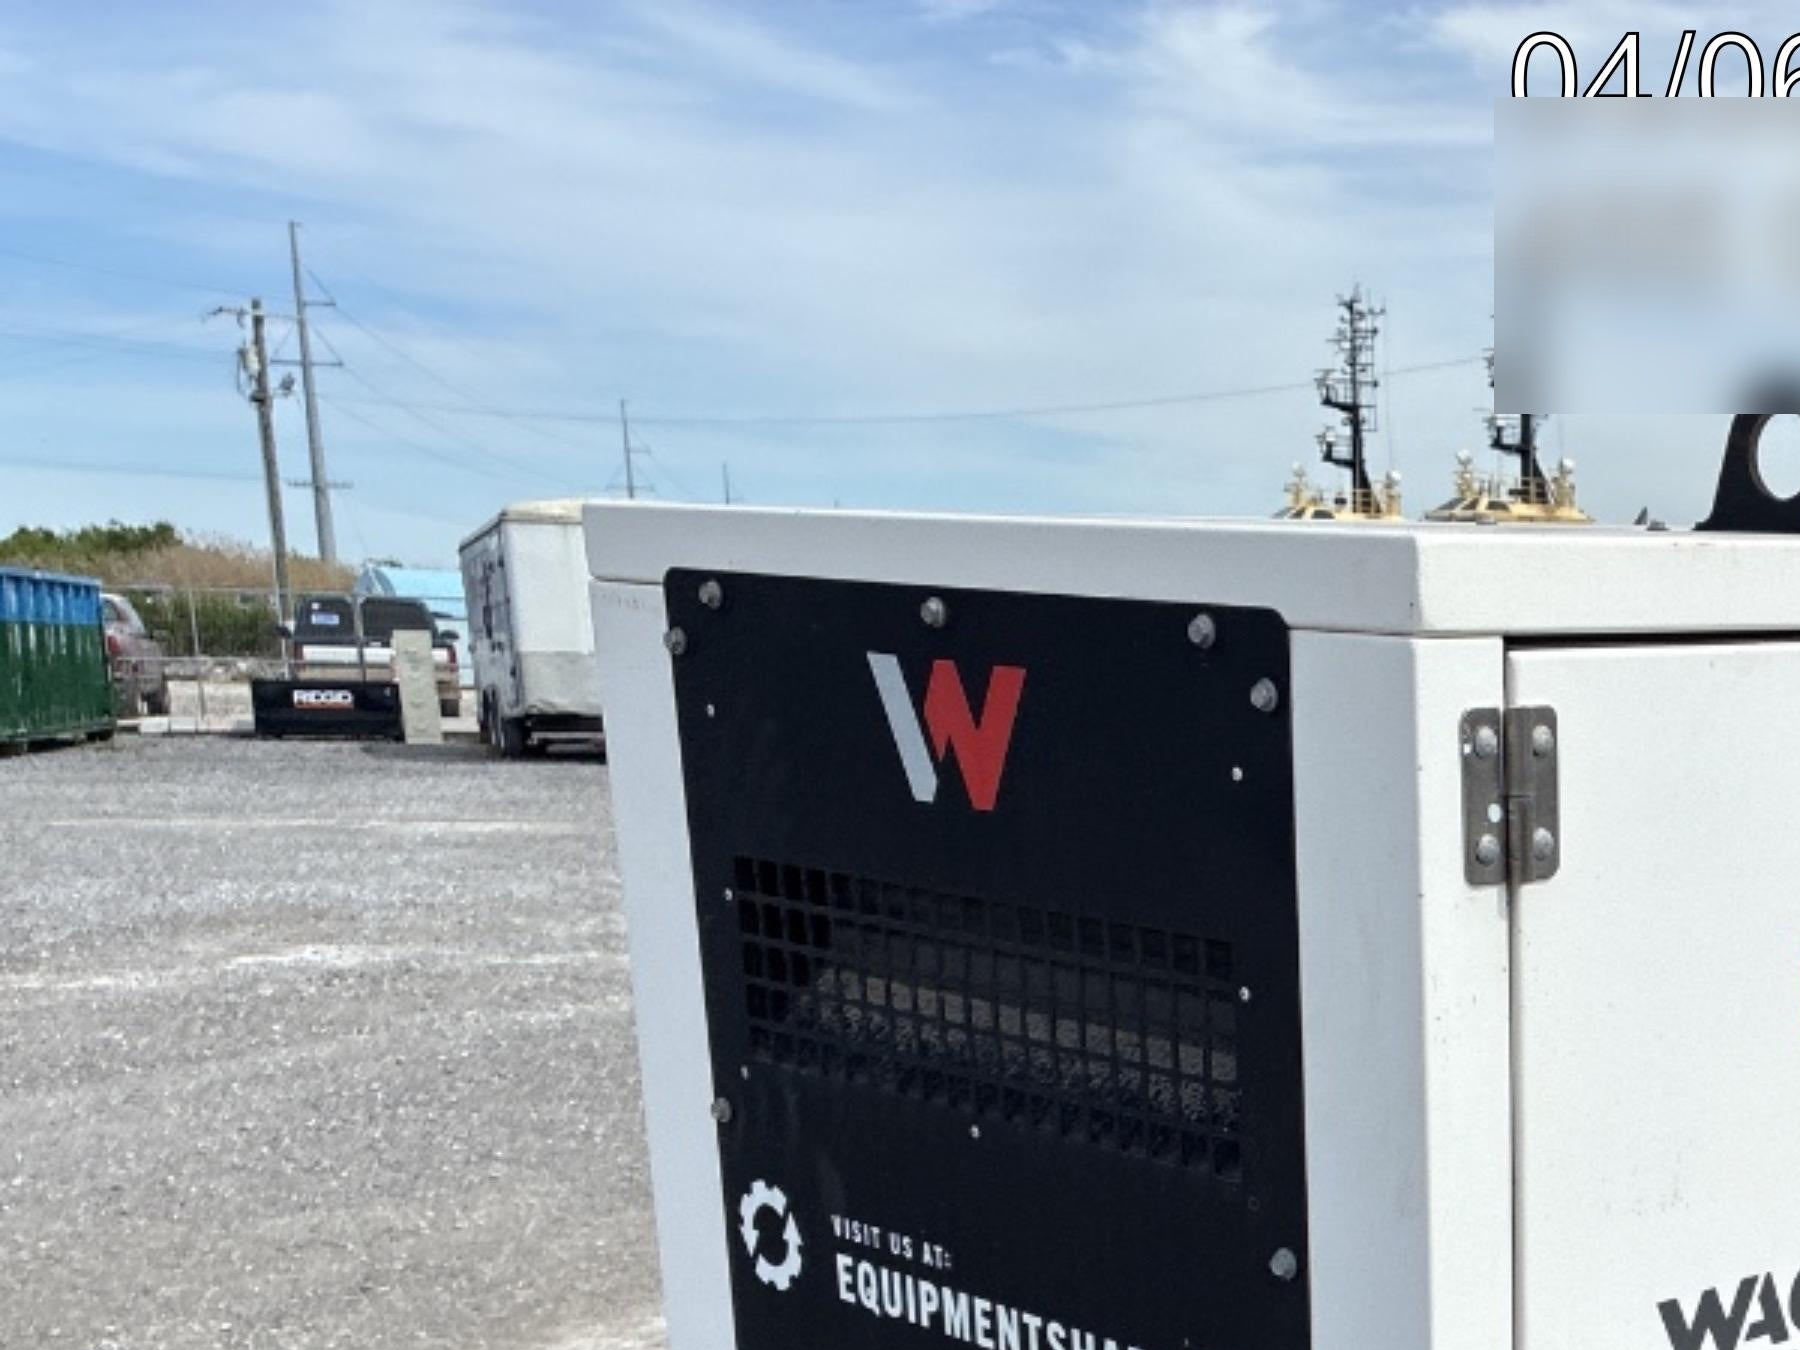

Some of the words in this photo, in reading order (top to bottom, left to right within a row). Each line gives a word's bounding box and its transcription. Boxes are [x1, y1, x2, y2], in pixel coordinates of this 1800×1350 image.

[830, 1213, 881, 1250] VISIT
[888, 1231, 913, 1260] US
[922, 1241, 953, 1270] AT:
